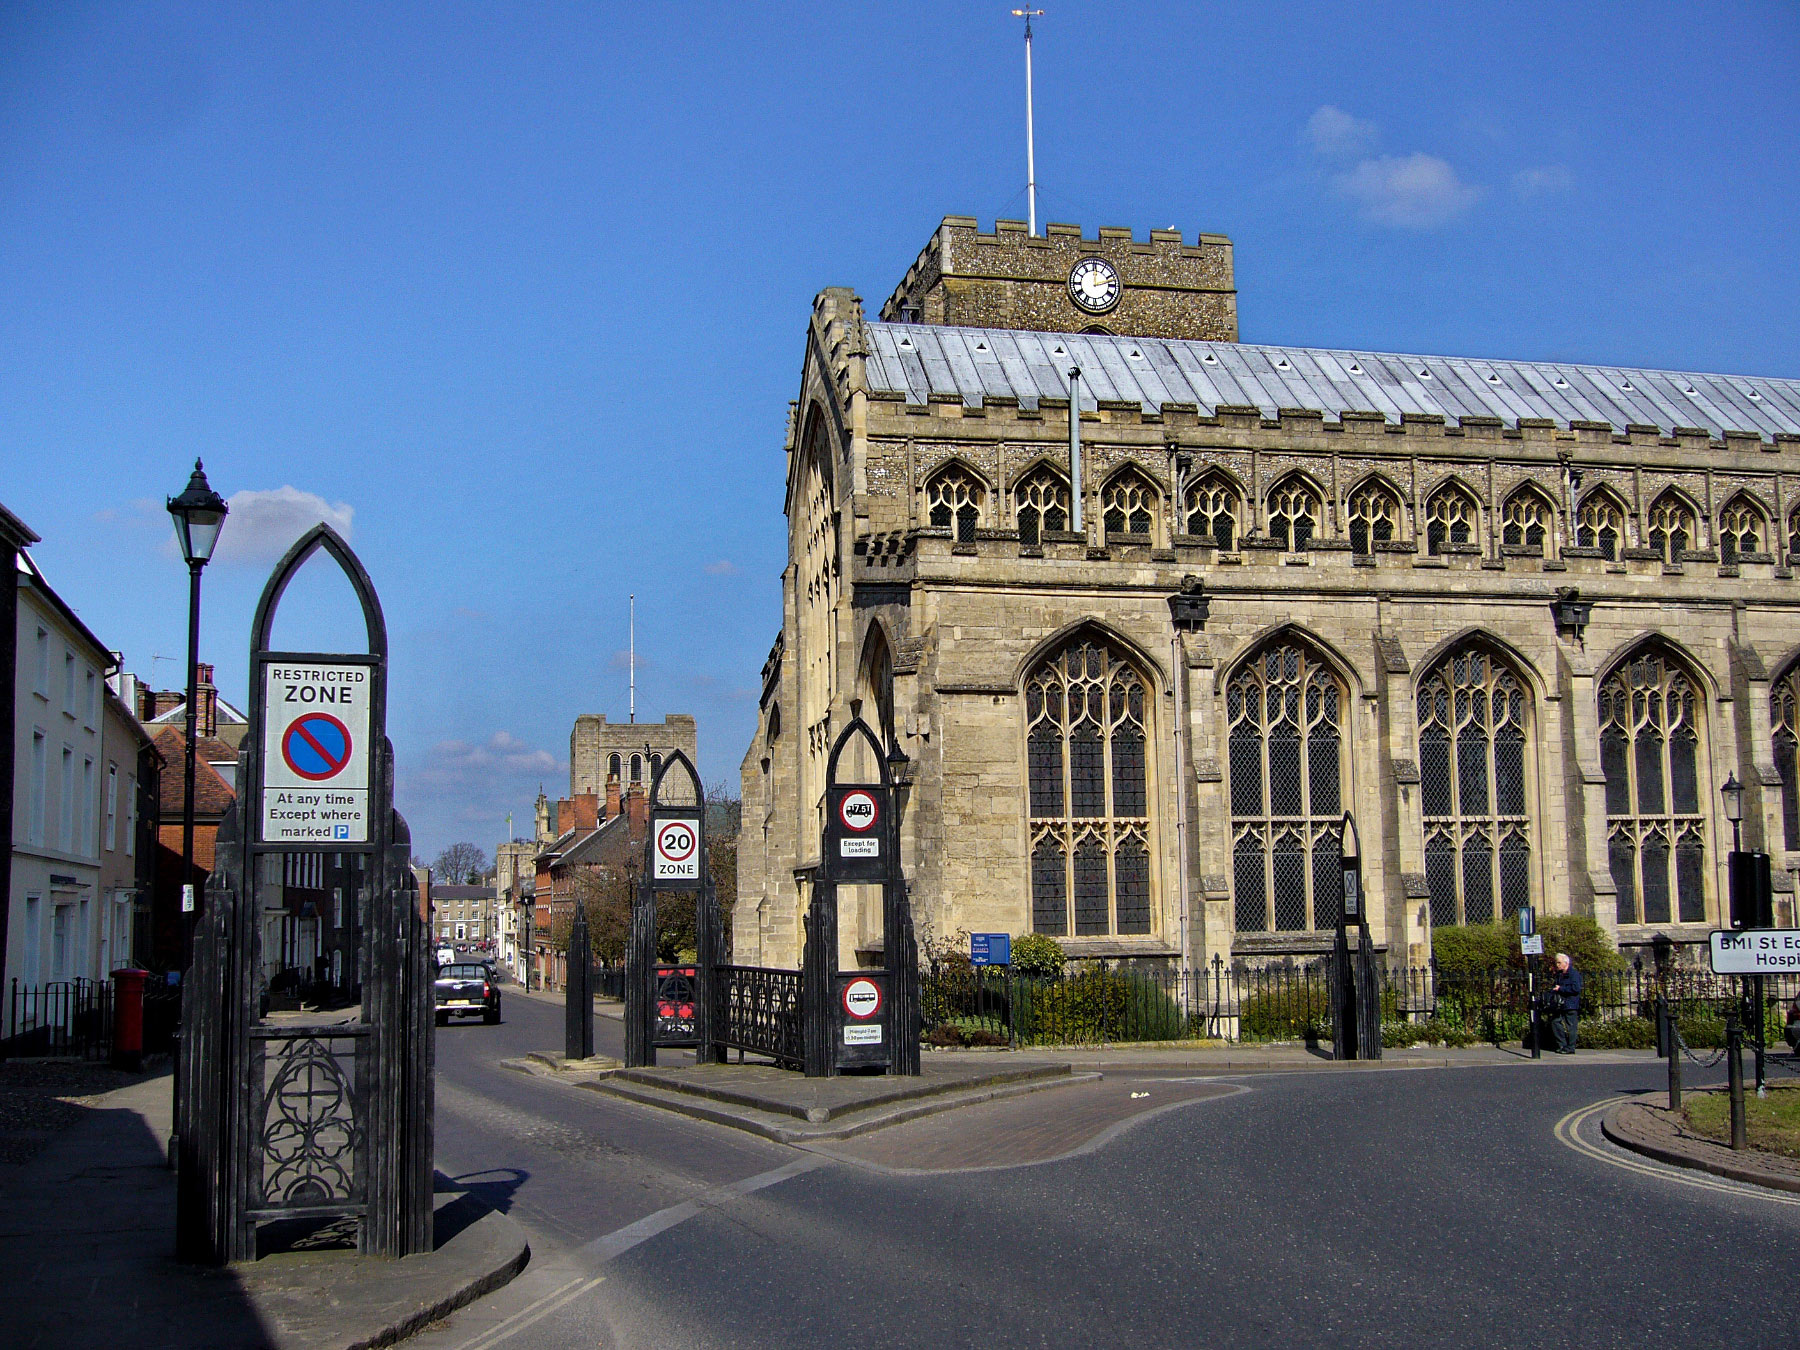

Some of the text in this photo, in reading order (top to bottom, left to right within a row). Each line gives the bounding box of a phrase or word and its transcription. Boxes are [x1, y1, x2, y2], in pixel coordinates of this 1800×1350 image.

[273, 669, 364, 682] RESTRICTED
[285, 685, 352, 704] ZONE
[277, 793, 354, 807] At any time
[270, 809, 361, 822] Except where
[281, 826, 331, 837] marked
[665, 834, 690, 850] 20
[660, 864, 694, 874] ZONE
[1720, 938, 1752, 950] BMI
[1759, 937, 1778, 949] St
